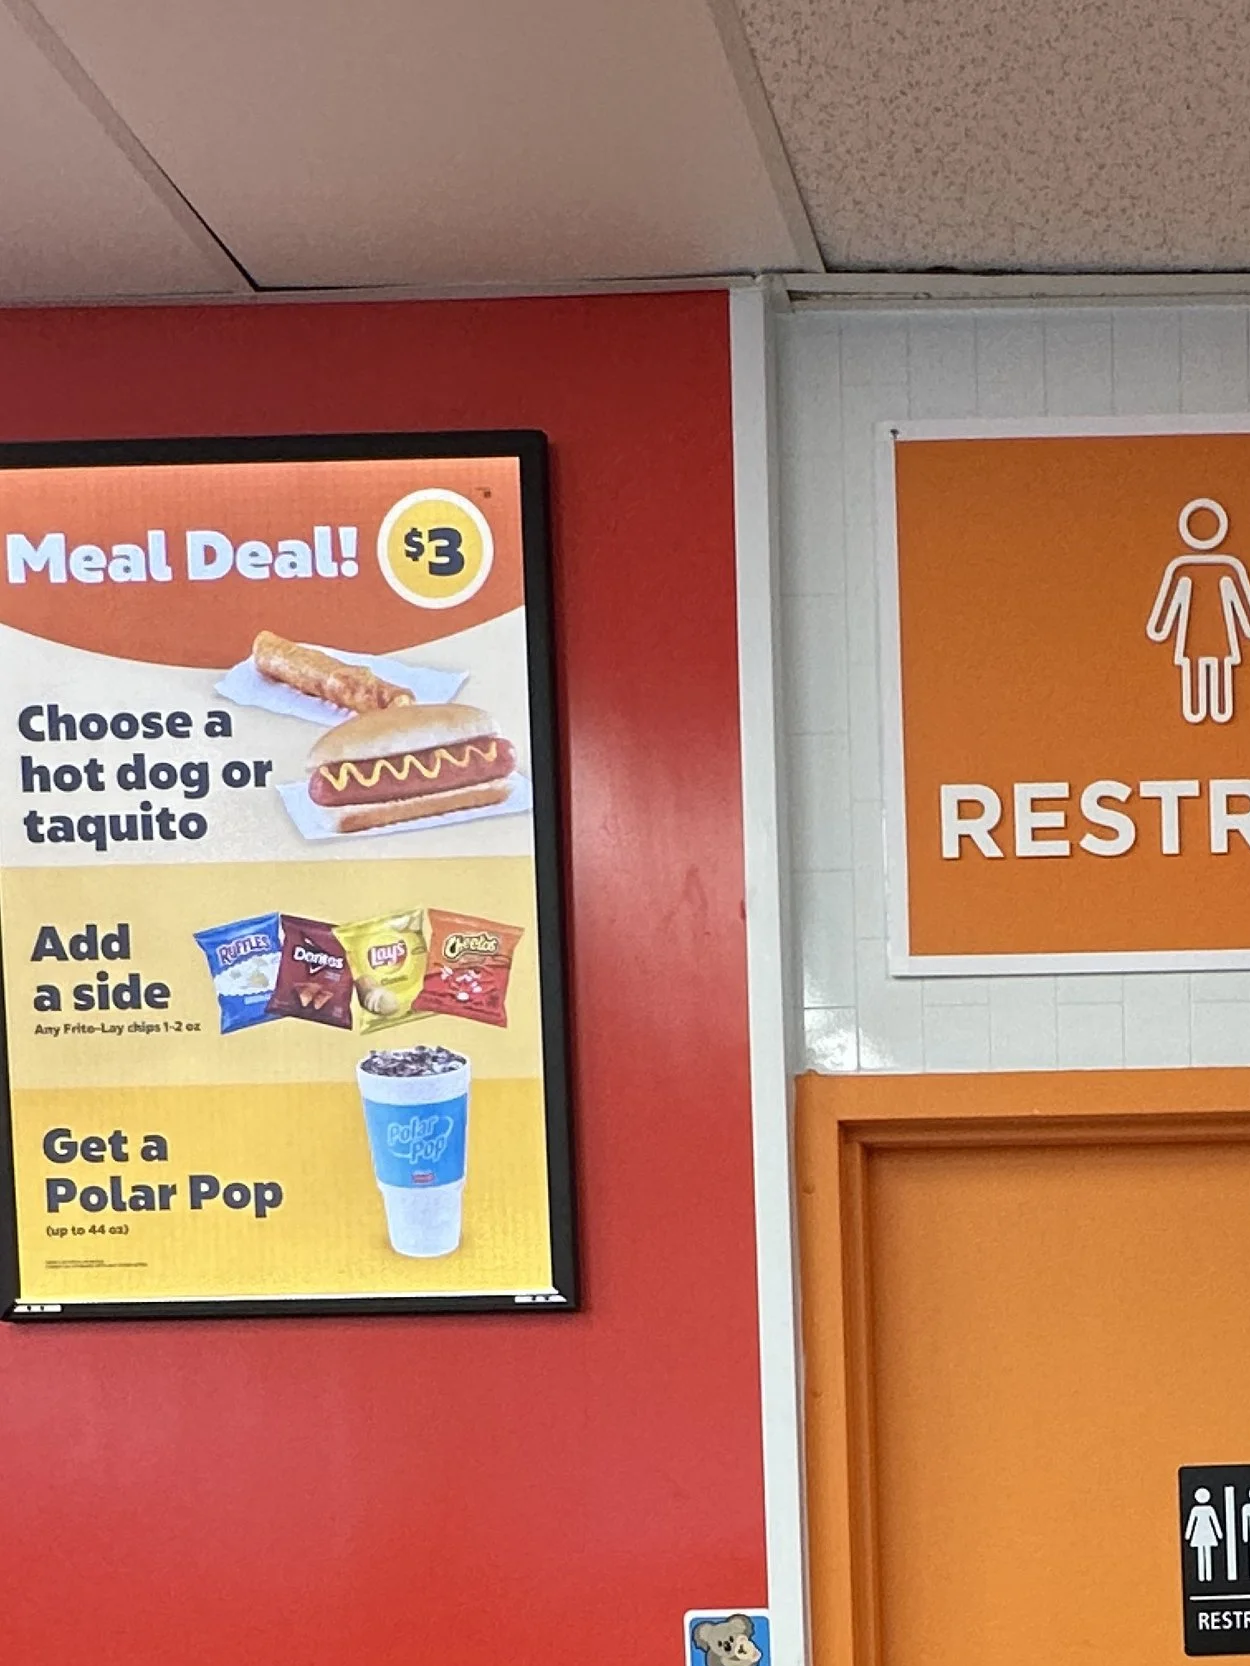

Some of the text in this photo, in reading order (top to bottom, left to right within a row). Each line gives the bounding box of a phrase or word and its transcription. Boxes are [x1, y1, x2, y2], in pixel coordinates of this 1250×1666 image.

[6, 525, 359, 584] Meal Deal!
[403, 526, 466, 576] $3
[18, 705, 233, 742] Choose a
[20, 753, 273, 799] hot dog or
[24, 801, 208, 851] taquito
[30, 923, 131, 962] Add
[33, 973, 171, 1012] a side
[34, 1023, 60, 1038] Any
[63, 1022, 125, 1036] Frito-Lay
[127, 1021, 161, 1035] chips
[185, 1022, 202, 1032] oz
[43, 1127, 168, 1163] Get a
[387, 1114, 440, 1147] Polar
[409, 1135, 448, 1165] Pop
[46, 1174, 284, 1219] Polar Pop
[71, 1225, 86, 1236] to
[88, 1224, 106, 1235] 44
